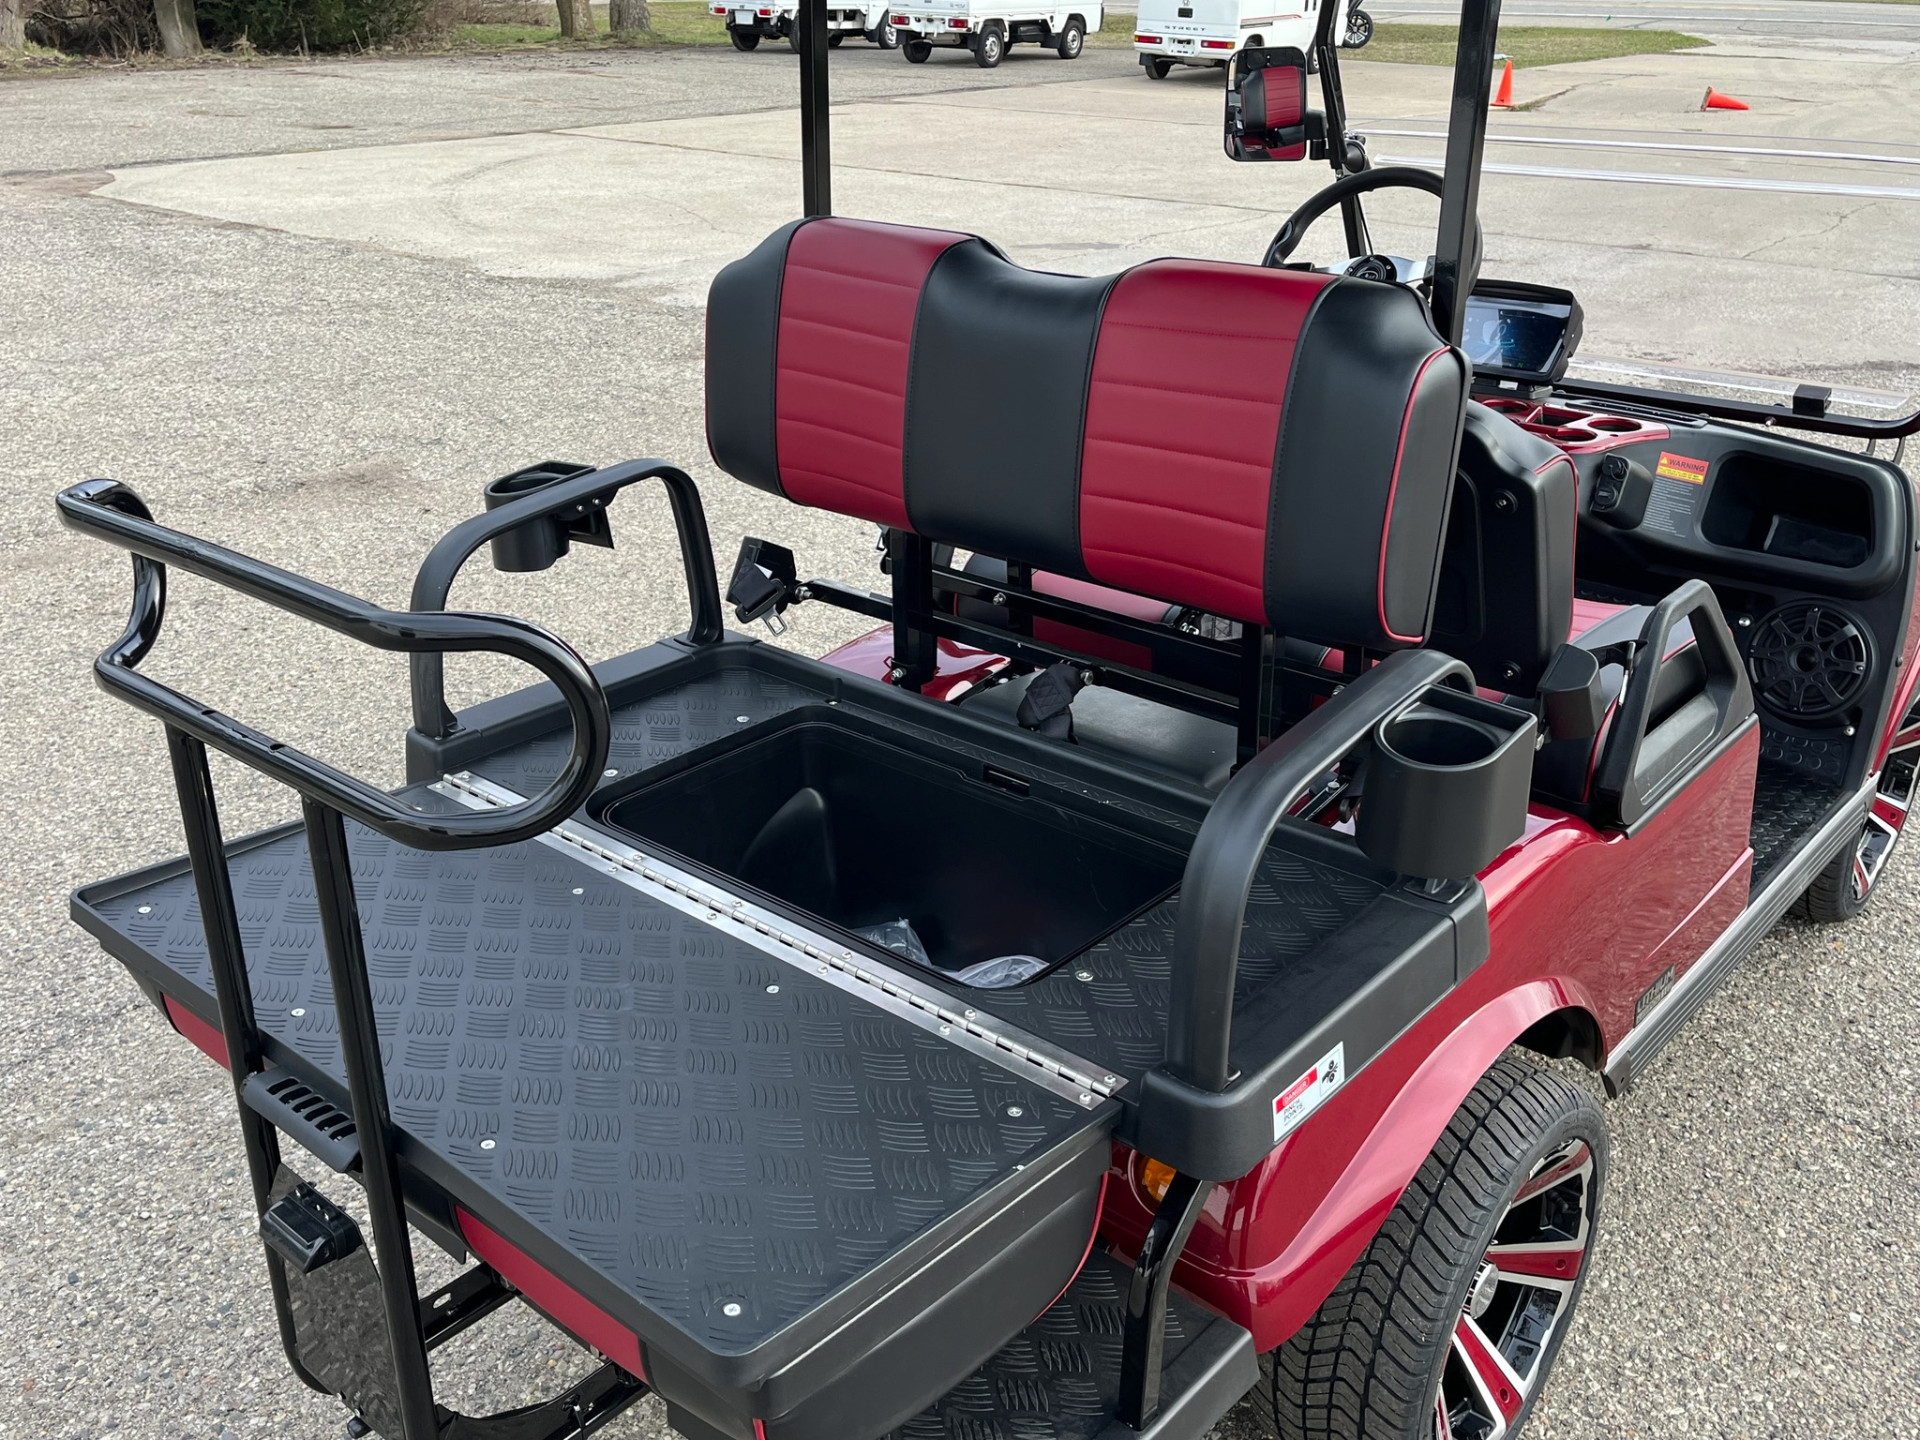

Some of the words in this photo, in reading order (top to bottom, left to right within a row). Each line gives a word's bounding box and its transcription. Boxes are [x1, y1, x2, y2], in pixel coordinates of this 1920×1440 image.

[1669, 459, 1705, 472] WARNING
[1637, 965, 1674, 1013] LITHIUM
[1284, 1080, 1307, 1102] DANGER
